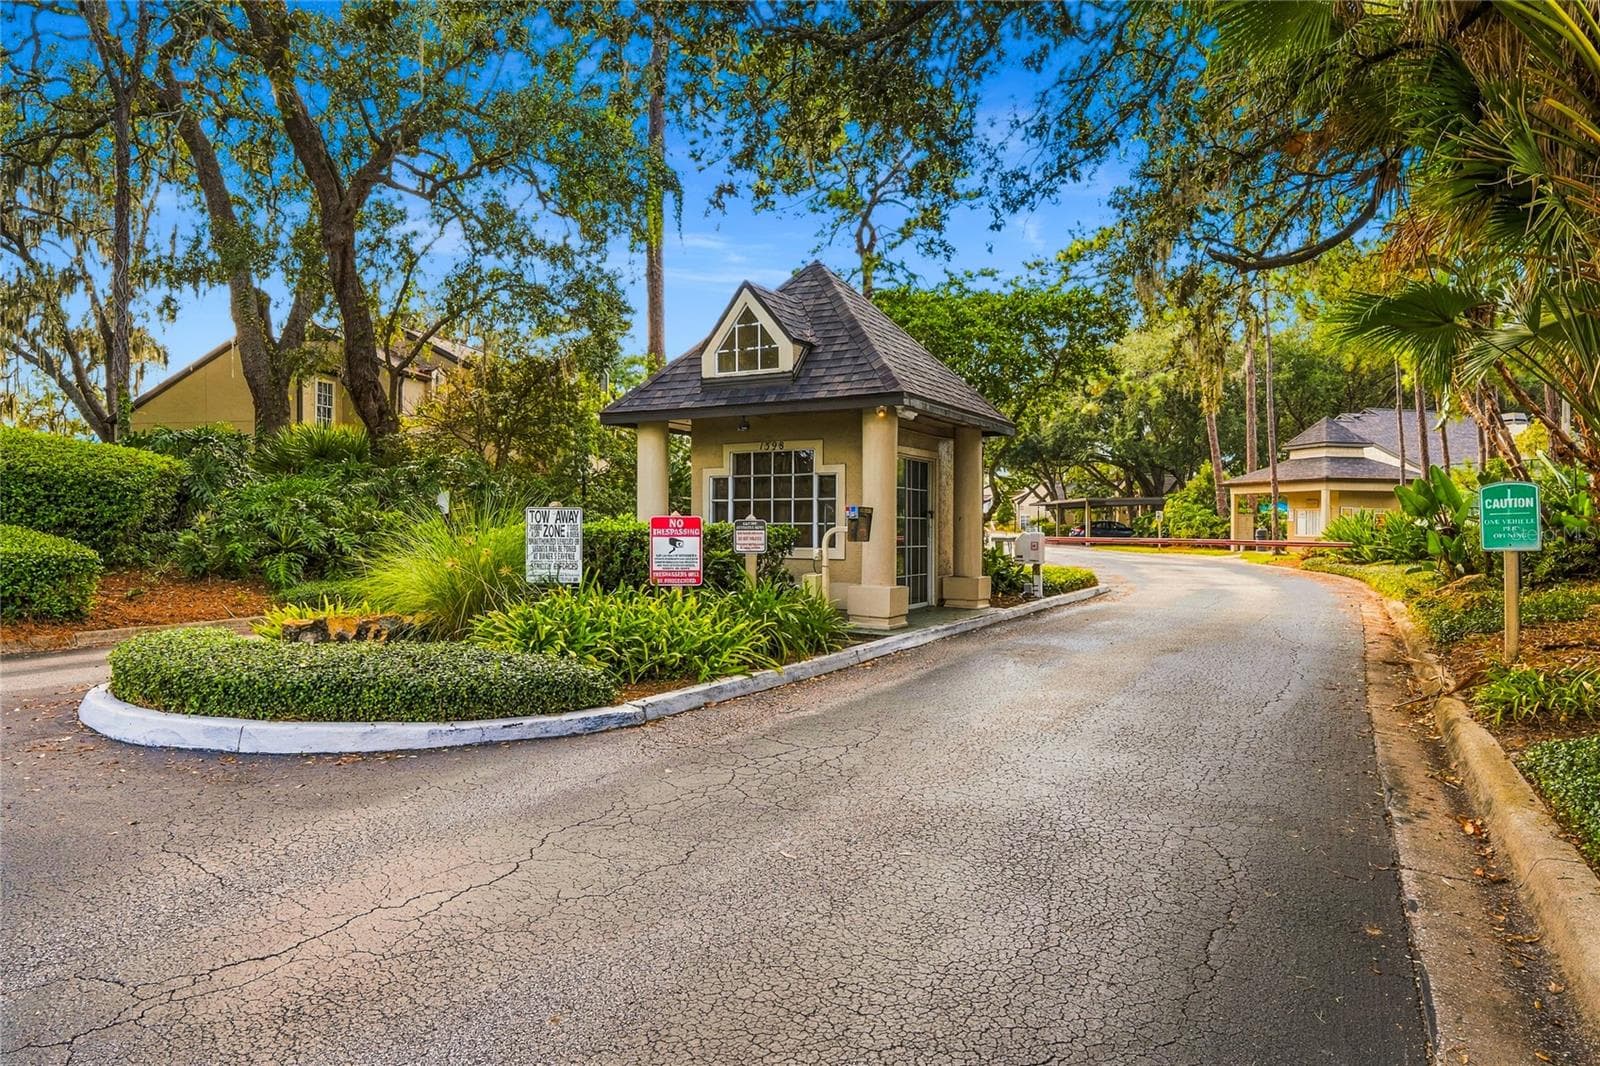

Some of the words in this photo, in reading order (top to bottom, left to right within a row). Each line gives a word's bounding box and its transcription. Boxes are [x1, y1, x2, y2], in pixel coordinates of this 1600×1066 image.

[1485, 498, 1534, 508] CAUTION
[529, 510, 550, 523] TOW
[555, 510, 579, 523] AWAY
[668, 518, 684, 528] NO
[543, 524, 566, 538] ZONE
